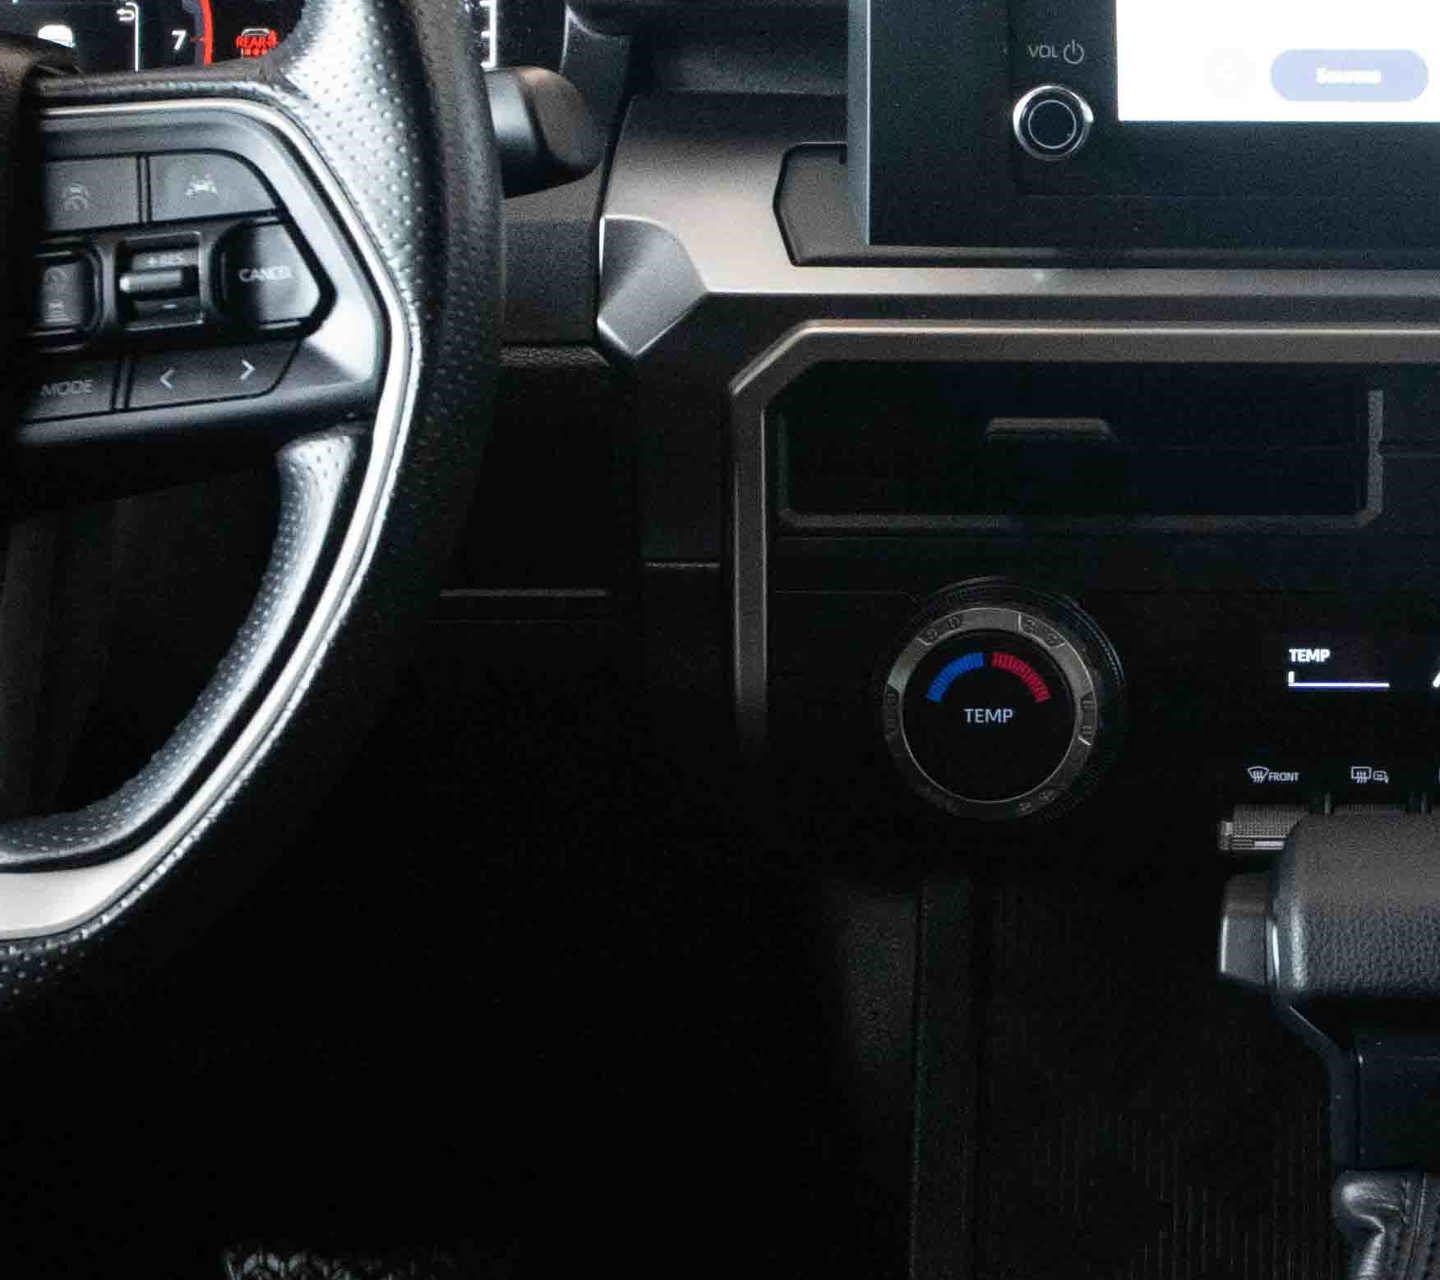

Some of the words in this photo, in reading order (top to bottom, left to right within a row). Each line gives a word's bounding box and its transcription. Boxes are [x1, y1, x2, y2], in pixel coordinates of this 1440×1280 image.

[172, 30, 187, 51] 7
[1028, 45, 1058, 58] VOL
[40, 380, 93, 397] MODE
[1289, 648, 1331, 663] TEMP
[964, 708, 1014, 723] TEMP
[1268, 772, 1300, 782] FRONT
